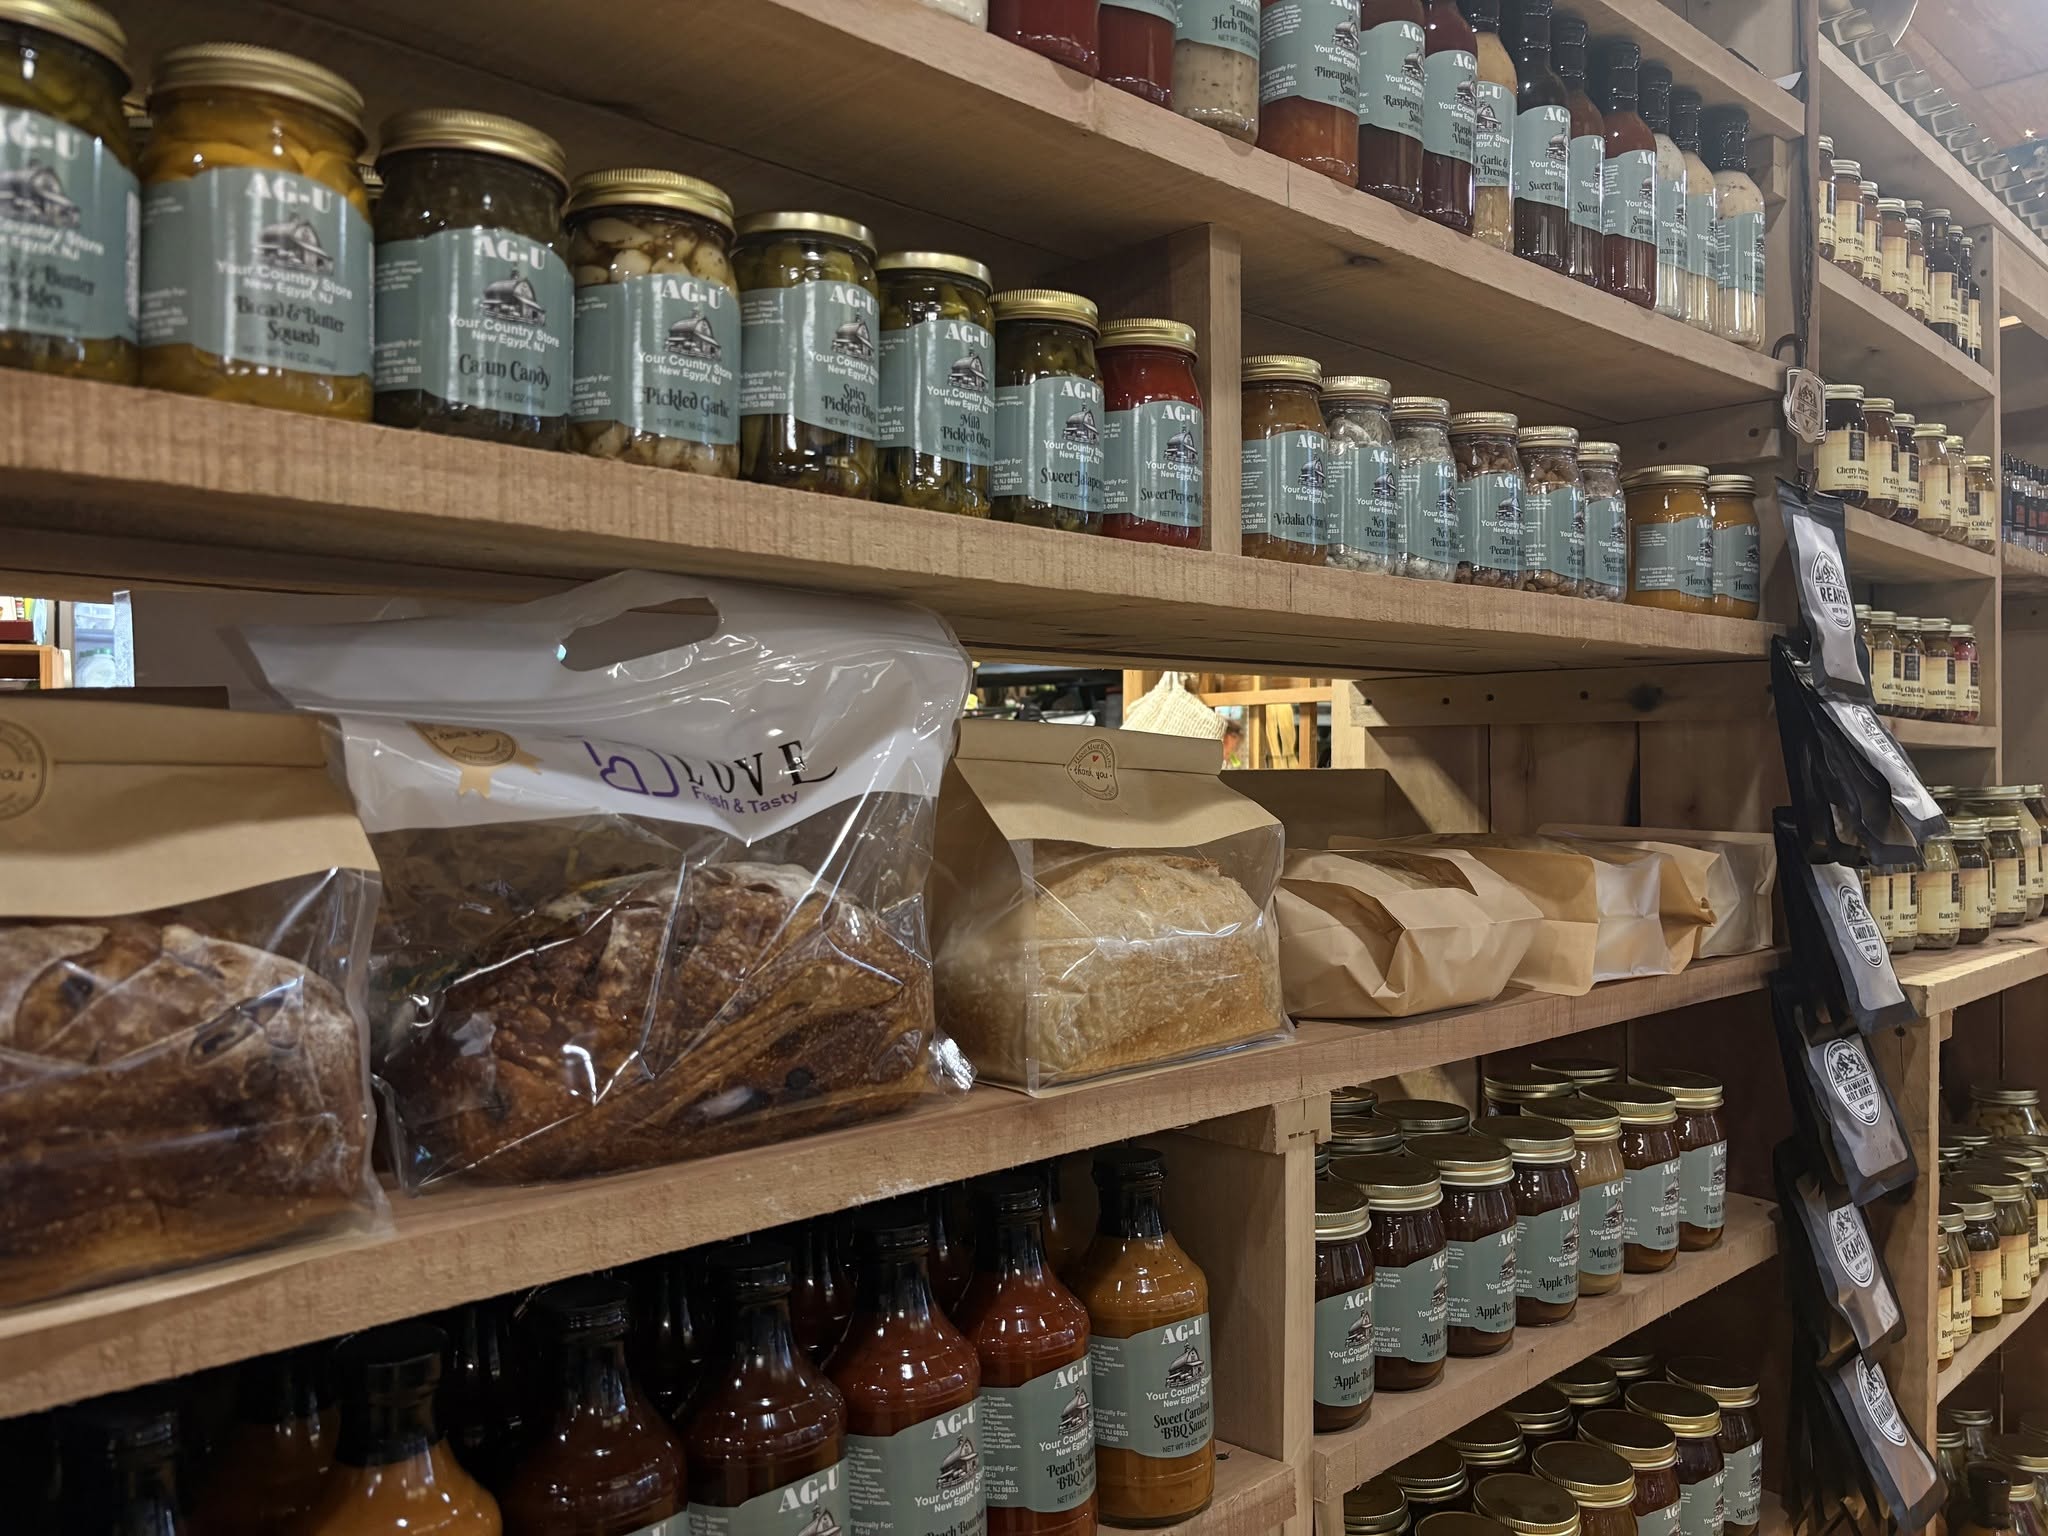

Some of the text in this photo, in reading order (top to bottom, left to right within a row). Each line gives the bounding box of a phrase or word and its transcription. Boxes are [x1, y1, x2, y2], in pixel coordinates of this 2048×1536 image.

[1212, 15, 1237, 30] Herb
[1314, 45, 1334, 54] Your
[1314, 66, 1354, 84] Pineapple
[1385, 74, 1404, 84] Your
[1476, 84, 1502, 99] G-U
[1383, 95, 1420, 113] Raspberry
[1438, 102, 1456, 112] Your
[1451, 110, 1463, 119] New
[1495, 134, 1510, 144] Store
[1480, 154, 1509, 167] Garlic &
[1530, 160, 1549, 169] Your
[245, 172, 333, 213] AG-U
[1528, 181, 1552, 192] Sweet
[1625, 200, 1642, 209] Your
[473, 235, 546, 270] AG-U
[216, 260, 353, 300] Your Country Store
[243, 279, 334, 304] New Egypt, NJ
[661, 279, 722, 310] AG-U
[829, 285, 875, 315] AG-U
[236, 296, 345, 333] Bread & Butter
[268, 320, 320, 347] Squash
[472, 330, 546, 352] New Egypt, NJ
[484, 319, 560, 348] Country Store
[945, 323, 991, 349] AG-U
[638, 352, 733, 381] Your Country Store
[809, 351, 869, 374] Your Country
[828, 365, 846, 376] New
[459, 354, 550, 391] Cajun Candy
[659, 365, 722, 385] New Egypt, NJ
[844, 384, 867, 402] Spicy
[927, 386, 983, 405] Your Country
[1060, 380, 1100, 403] AG-U
[643, 387, 730, 419] Pickled Garlic
[821, 396, 861, 416] Pickled
[944, 398, 989, 414] New Egypt, NJ
[960, 413, 980, 429] Mild
[1162, 404, 1198, 425] AG-U
[940, 425, 991, 449] Pickled Okra
[1043, 440, 1094, 456] Your Country
[1059, 451, 1075, 460] New
[1076, 452, 1094, 464] Egypt,
[1040, 467, 1074, 484] Sweet
[1146, 460, 1194, 476] Your Country
[1161, 470, 1175, 479] New
[1176, 471, 1193, 482] Egypt,
[1836, 466, 1857, 477] Cherry
[1141, 488, 1193, 506] Sweet Pepper
[1282, 485, 1300, 494] Your
[1274, 512, 1305, 526] Vidalia
[1372, 516, 1385, 528] Key
[1365, 527, 1385, 538] Pecan
[1489, 545, 1511, 555] Pecan
[734, 801, 744, 814] &
[748, 790, 799, 815] Tasty
[1656, 1225, 1674, 1236] Peach
[1486, 1281, 1500, 1291] Your
[1537, 1274, 1563, 1291] Apple
[1417, 1309, 1432, 1318] Your
[1474, 1302, 1501, 1321] Apple
[1160, 1317, 1203, 1345] AG-U
[1420, 1329, 1441, 1347] Apple
[1329, 1341, 1371, 1359] Your Country
[1333, 1372, 1360, 1391] Apple
[1146, 1384, 1200, 1402] Your Country
[1163, 1391, 1200, 1408] New Egypt,
[931, 1403, 977, 1440] AG-U
[1153, 1404, 1210, 1430] Sweet Carolina
[1161, 1417, 1209, 1440] BBQ Sauce
[1039, 1428, 1088, 1452] Your Country
[1162, 1445, 1174, 1453] NET
[1056, 1447, 1071, 1457] New
[1046, 1462, 1075, 1478] Peach
[778, 1464, 840, 1513] AG-U
[1056, 1472, 1079, 1490] BBQ
[914, 1482, 974, 1507] Your Country
[934, 1490, 974, 1513] New Egypt,
[1739, 1489, 1750, 1498] Your
